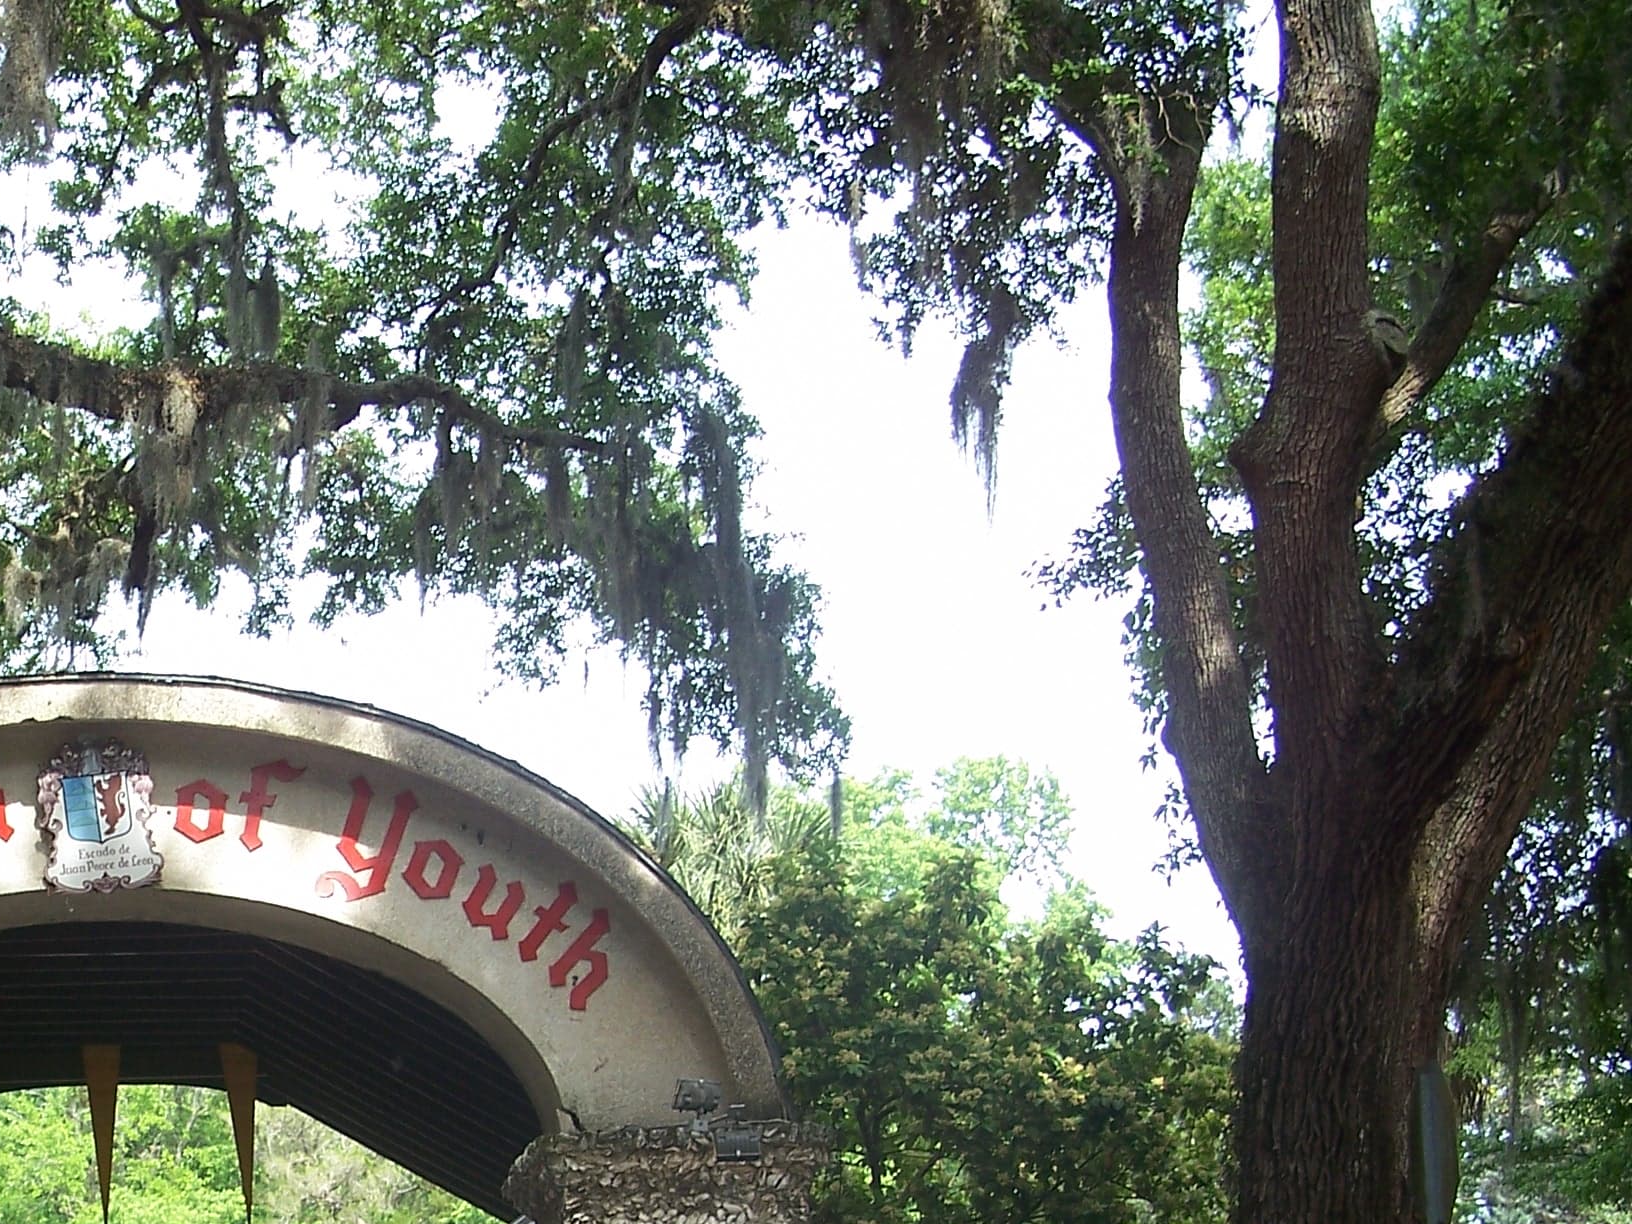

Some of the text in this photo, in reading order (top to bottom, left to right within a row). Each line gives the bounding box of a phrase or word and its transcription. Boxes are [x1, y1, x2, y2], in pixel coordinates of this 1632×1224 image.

[78, 843, 130, 860] Escudo de
[60, 863, 86, 876] Juan
[118, 856, 129, 869] de
[173, 759, 307, 852] of
[315, 776, 611, 1011] Youth
